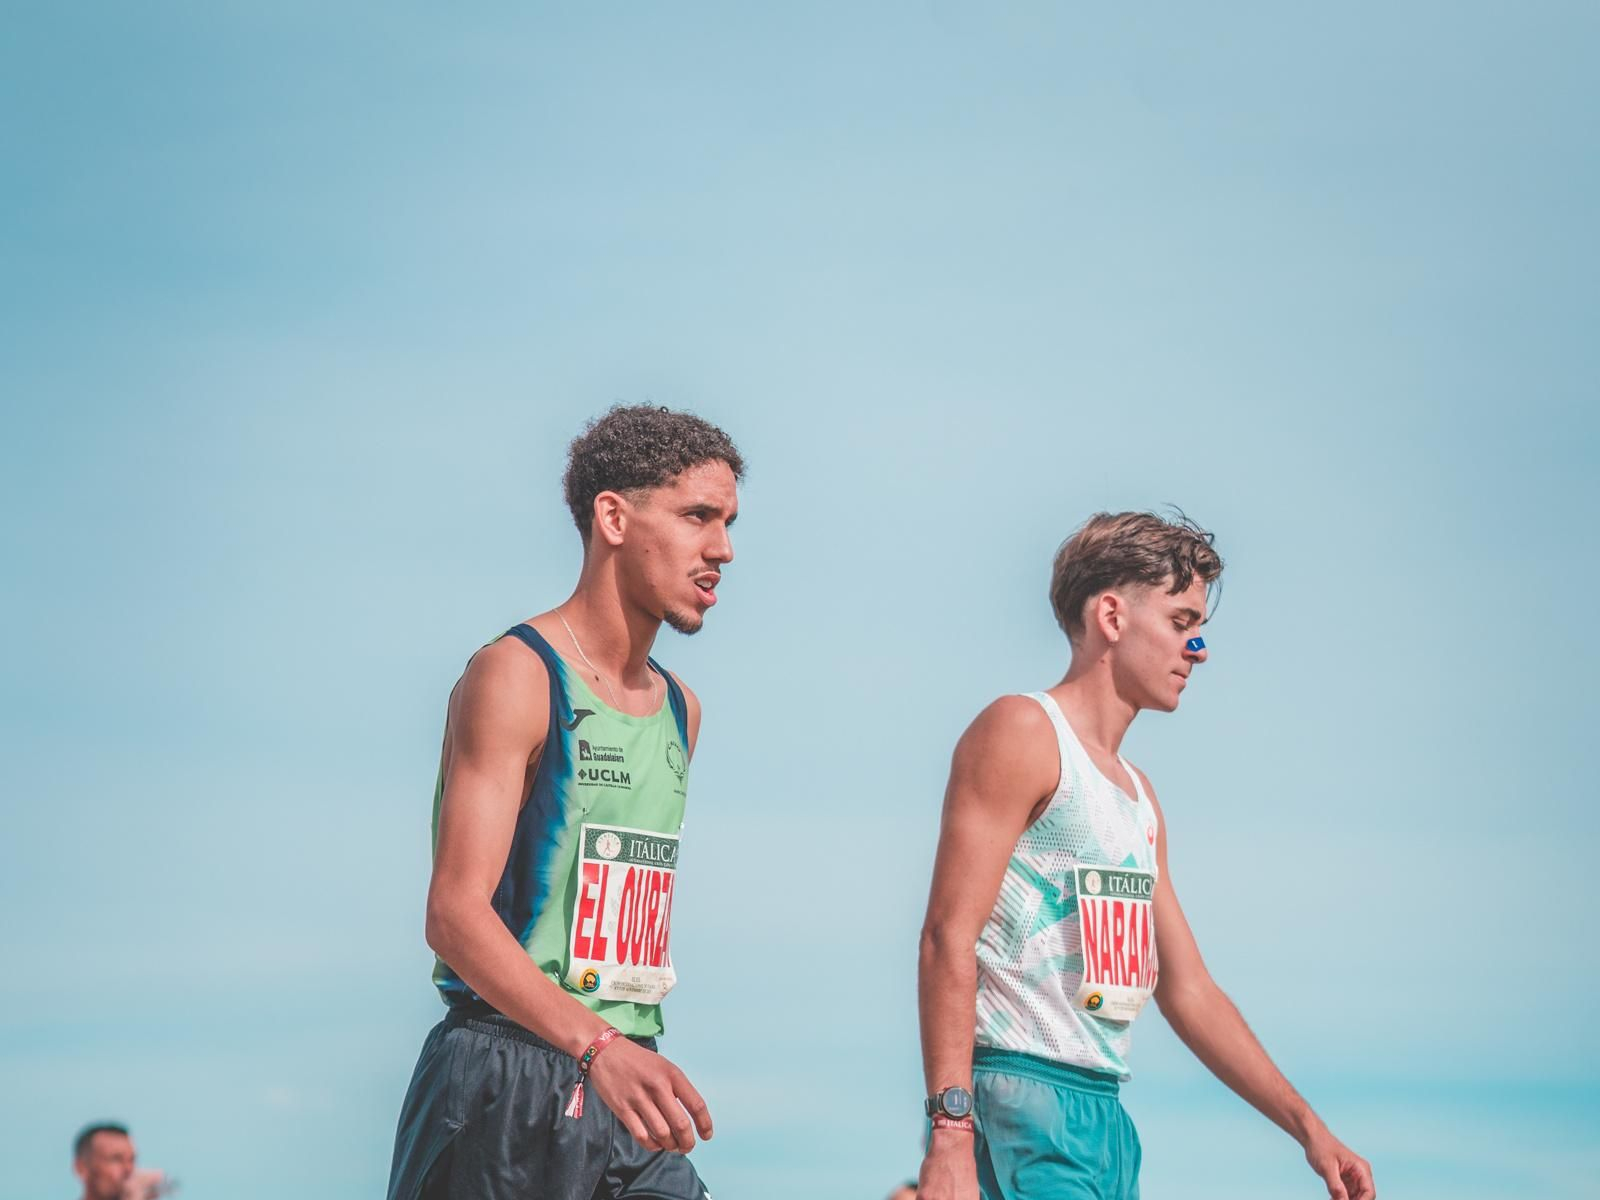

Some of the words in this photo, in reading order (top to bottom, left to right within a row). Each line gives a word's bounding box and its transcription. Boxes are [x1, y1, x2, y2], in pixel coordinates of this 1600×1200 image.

[588, 768, 631, 785] UCLM
[1108, 873, 1150, 896] ITÁLIC
[574, 863, 609, 961] EL
